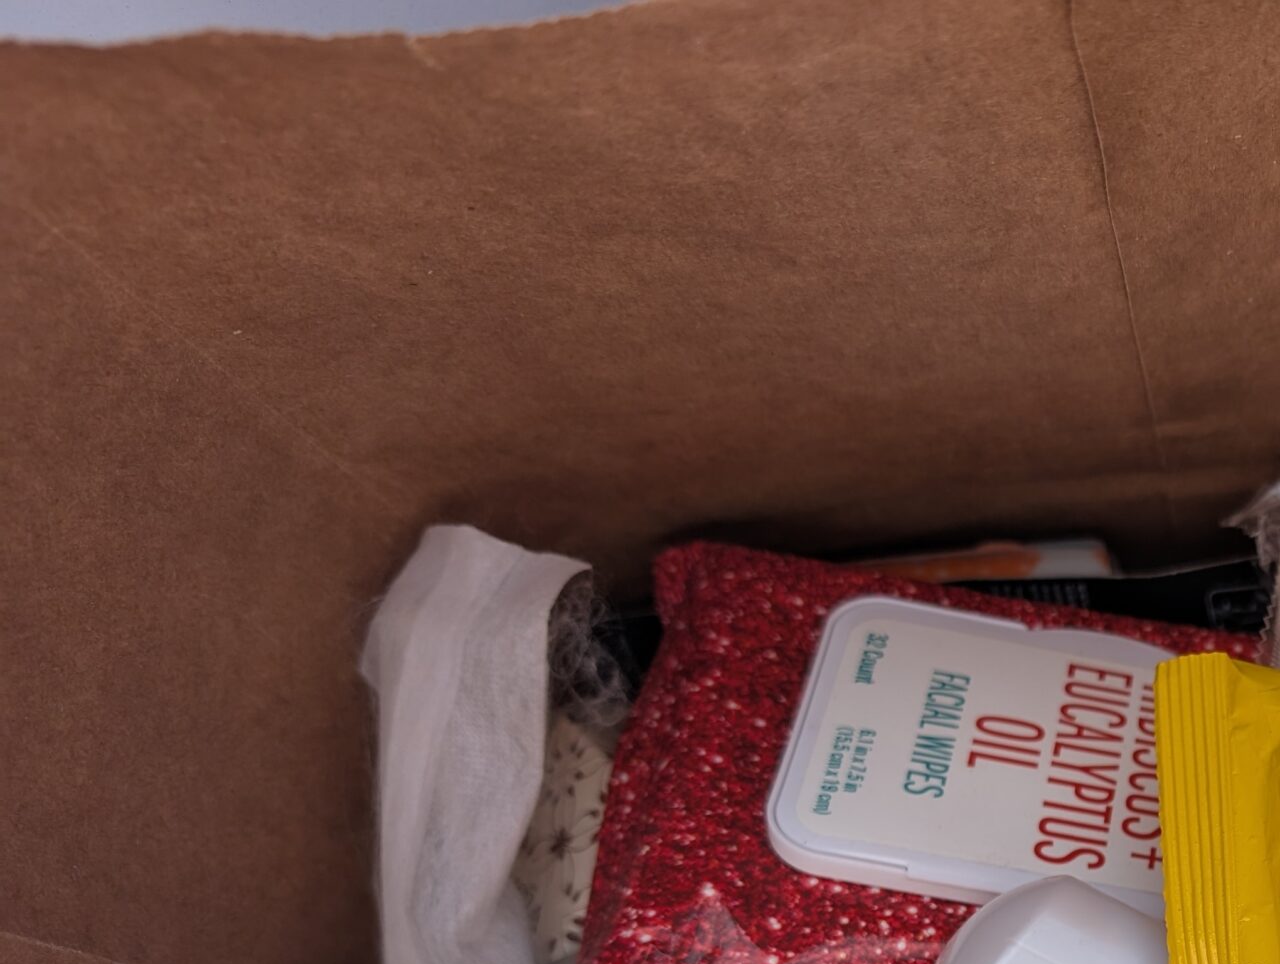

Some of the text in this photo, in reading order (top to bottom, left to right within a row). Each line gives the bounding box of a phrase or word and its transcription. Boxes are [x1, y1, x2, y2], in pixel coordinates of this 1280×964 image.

[855, 633, 889, 684] 32 Count
[858, 729, 876, 744] 6.1
[903, 670, 971, 798] FACIAL WIPES
[967, 716, 1045, 768] OIL
[854, 746, 868, 756] in
[1034, 663, 1134, 869] EUCALYPTUS
[844, 782, 857, 792] in
[847, 765, 867, 781] 7.5
